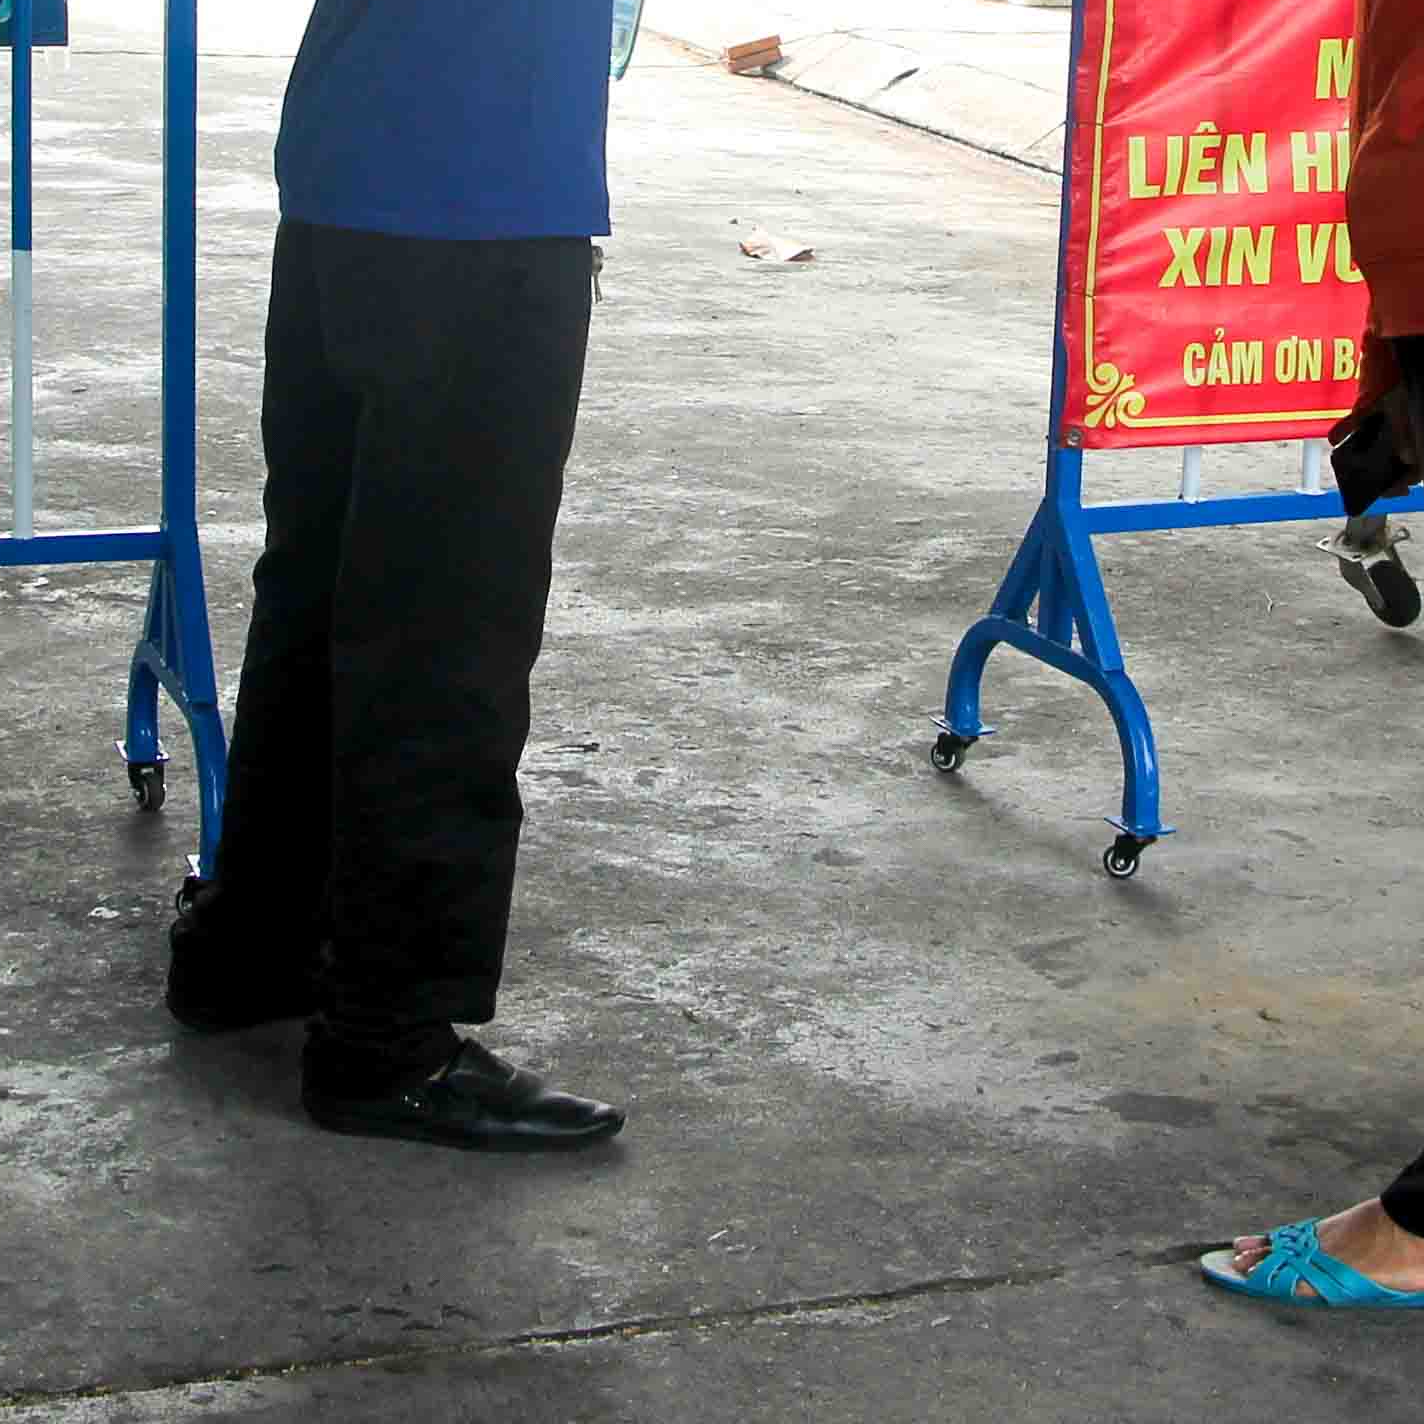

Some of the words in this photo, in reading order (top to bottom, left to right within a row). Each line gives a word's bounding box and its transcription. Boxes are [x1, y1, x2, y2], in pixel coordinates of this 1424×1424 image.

[1128, 122, 1268, 198] LIÊN
[1159, 224, 1274, 287] XIN
[1296, 223, 1365, 284] VU
[1182, 329, 1263, 386] CẢM
[1274, 335, 1323, 384] ƠN
